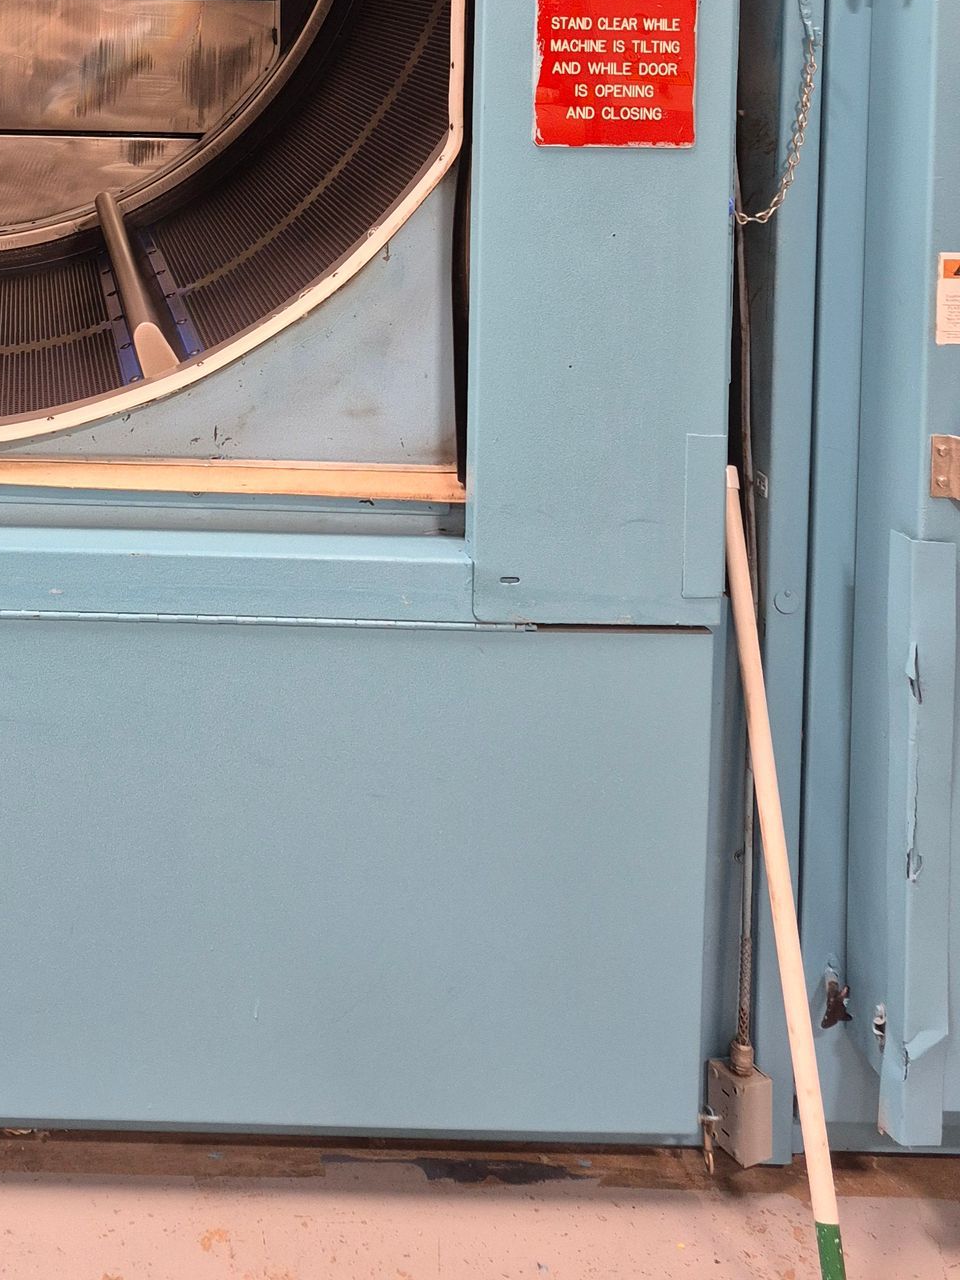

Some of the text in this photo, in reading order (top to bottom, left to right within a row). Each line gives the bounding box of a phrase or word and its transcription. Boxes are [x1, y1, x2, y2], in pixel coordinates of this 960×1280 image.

[551, 16, 681, 31] STAND CLEAR WHILE
[550, 39, 680, 54] MACHINE IS TILTING
[552, 61, 678, 76] AND WHILE DOOR
[575, 84, 654, 98] IS OPENING
[566, 106, 663, 121] AND CLOSING
